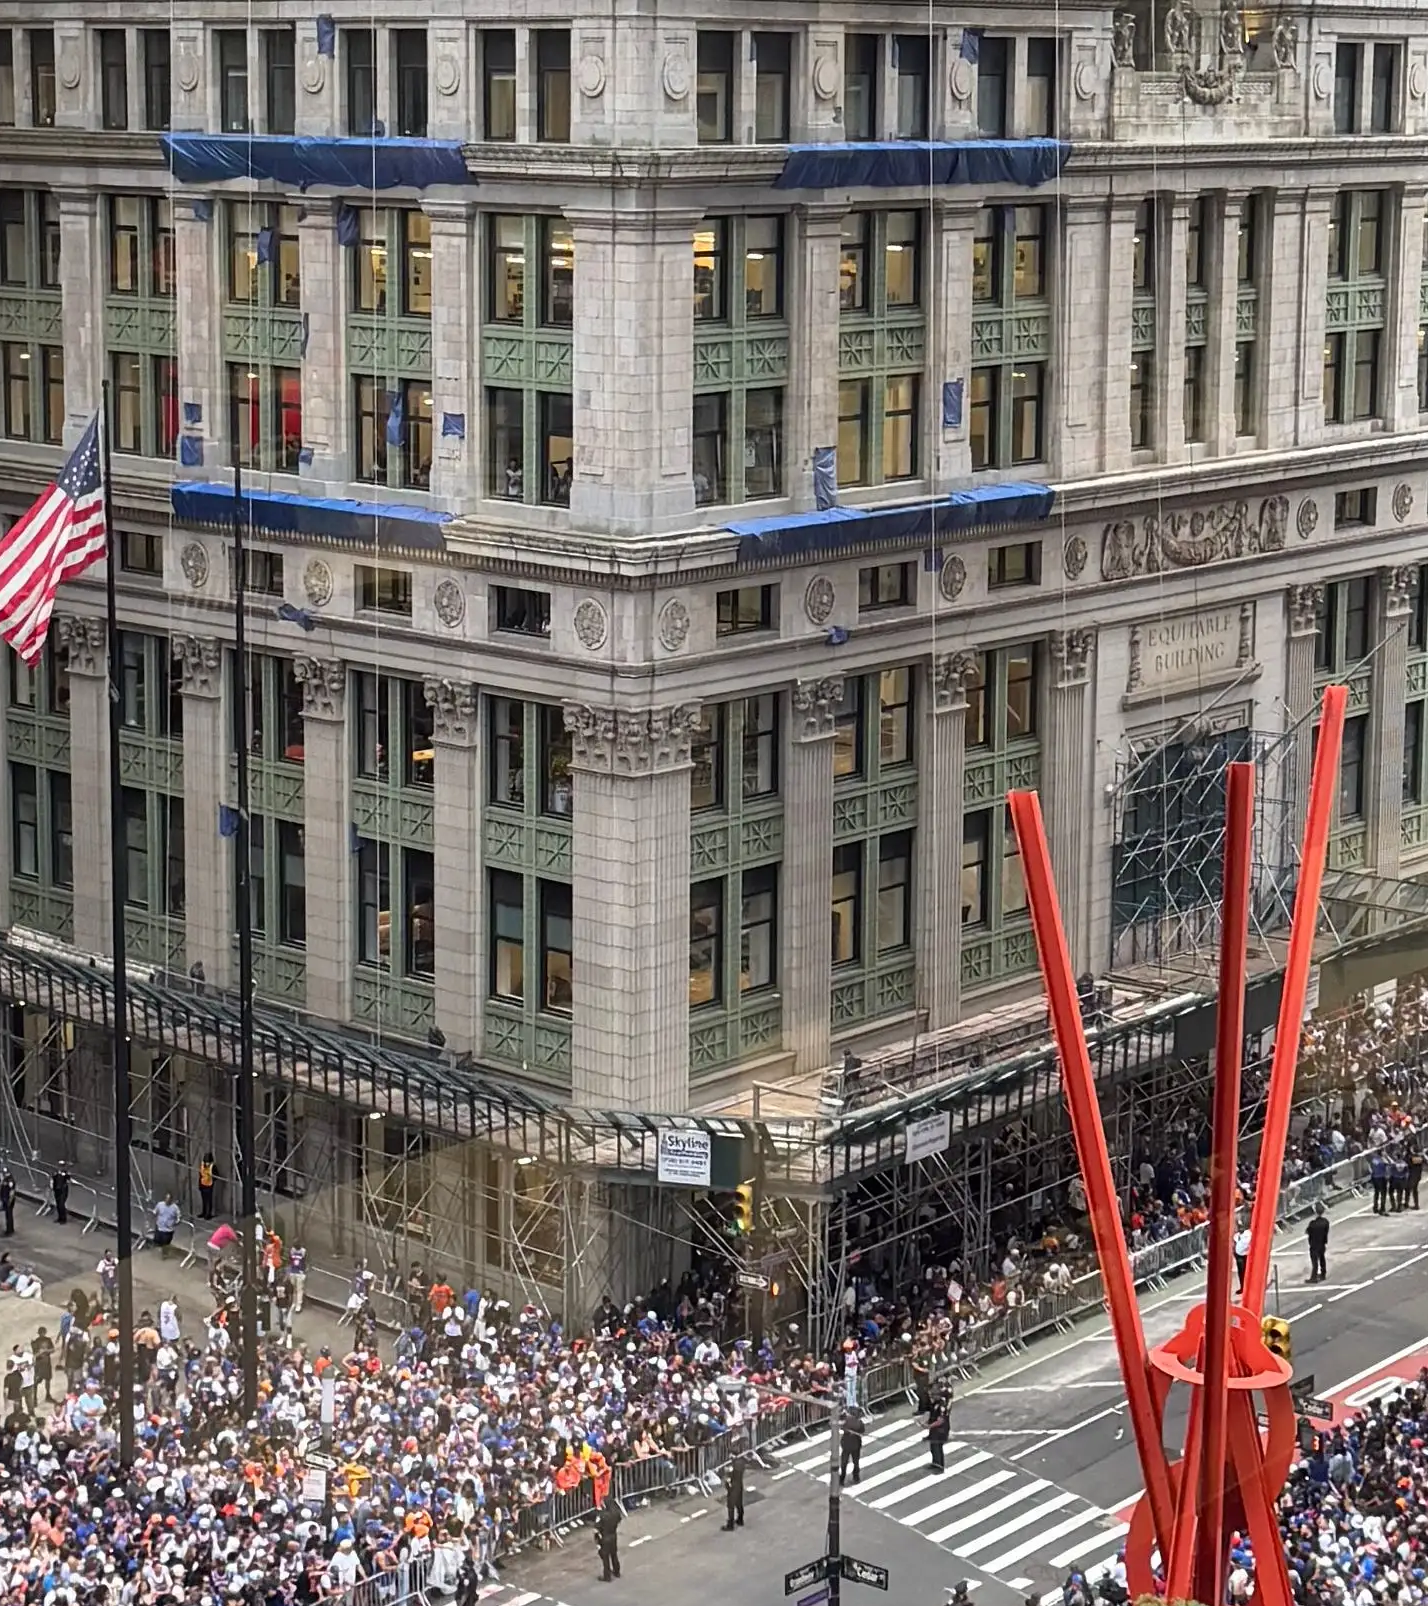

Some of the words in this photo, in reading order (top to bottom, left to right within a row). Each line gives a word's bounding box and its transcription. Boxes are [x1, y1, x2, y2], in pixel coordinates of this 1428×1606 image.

[1148, 613, 1232, 647] EQUITABLE
[1155, 642, 1225, 673] BUILDING
[667, 1135, 709, 1152] Skyline
